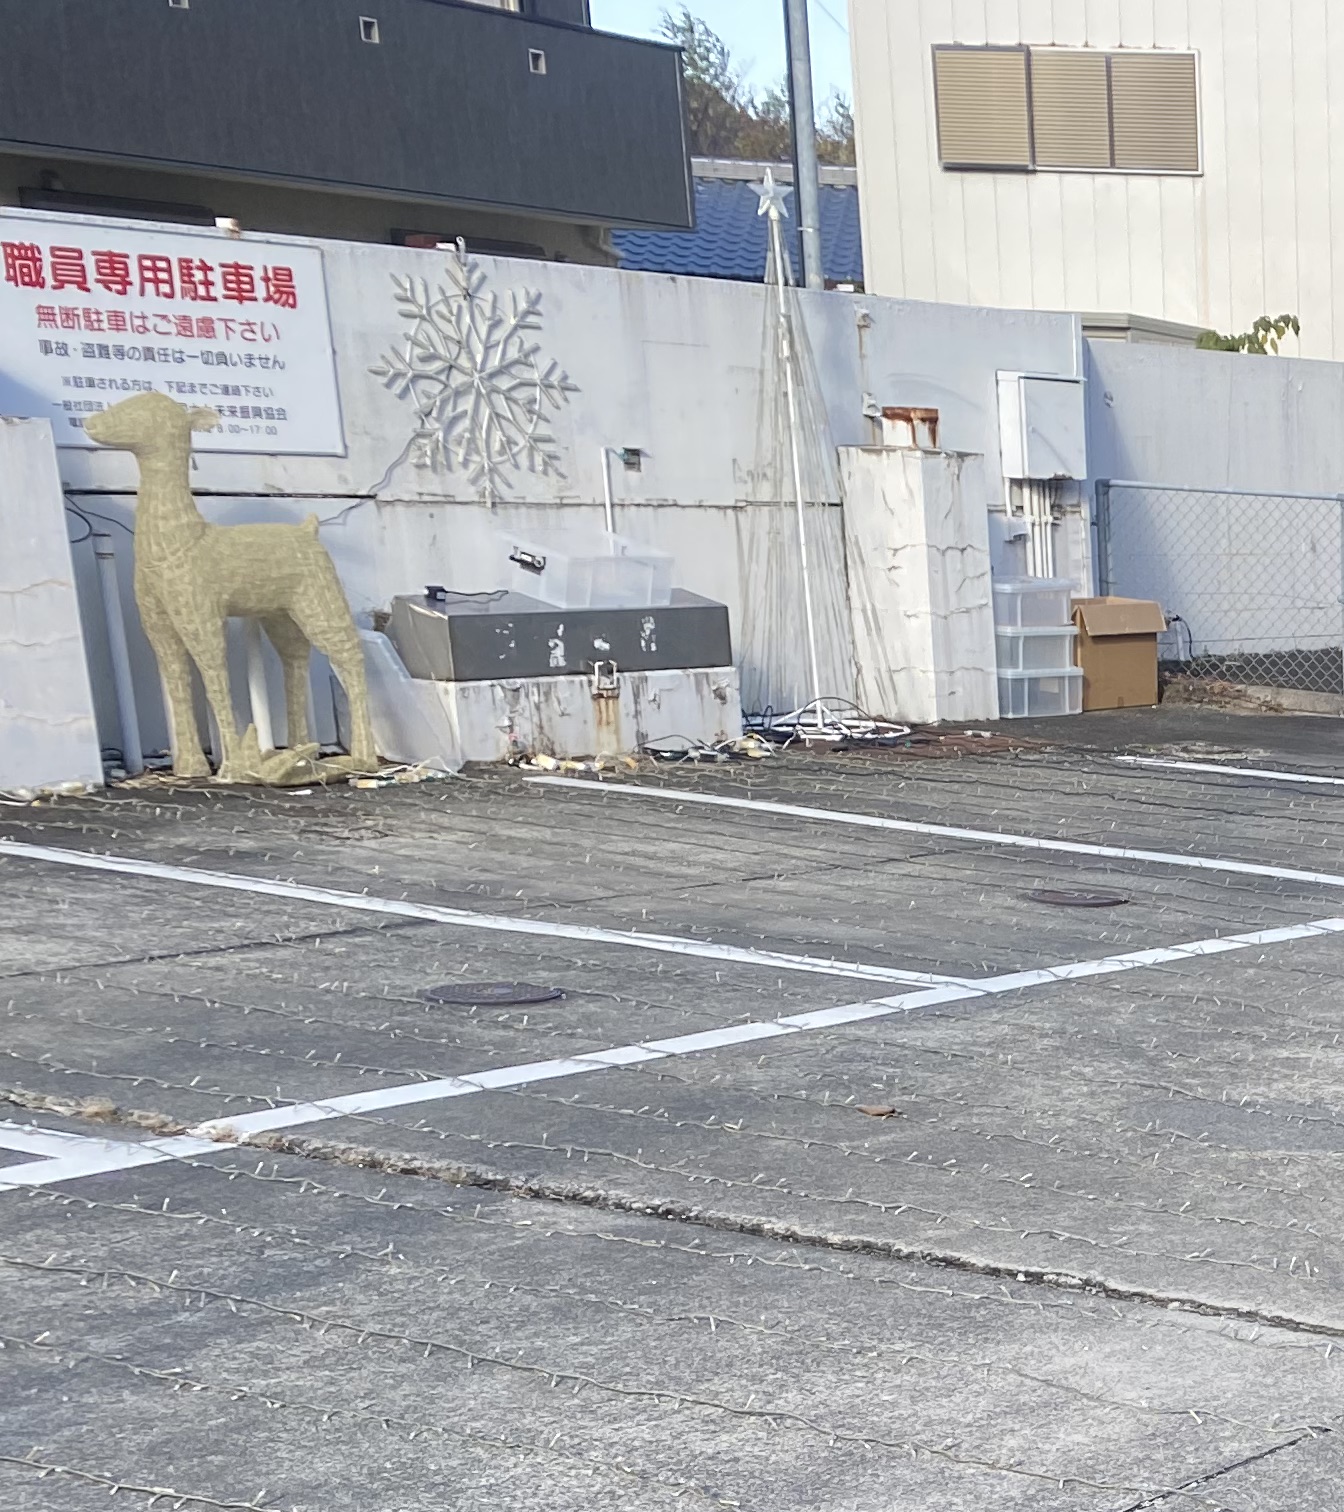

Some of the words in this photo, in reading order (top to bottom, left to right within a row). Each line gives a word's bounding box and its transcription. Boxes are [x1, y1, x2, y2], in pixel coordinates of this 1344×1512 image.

[1, 241, 298, 308] 職員専用駐車場
[35, 304, 281, 342] 無断駐車はご遠慮下さい
